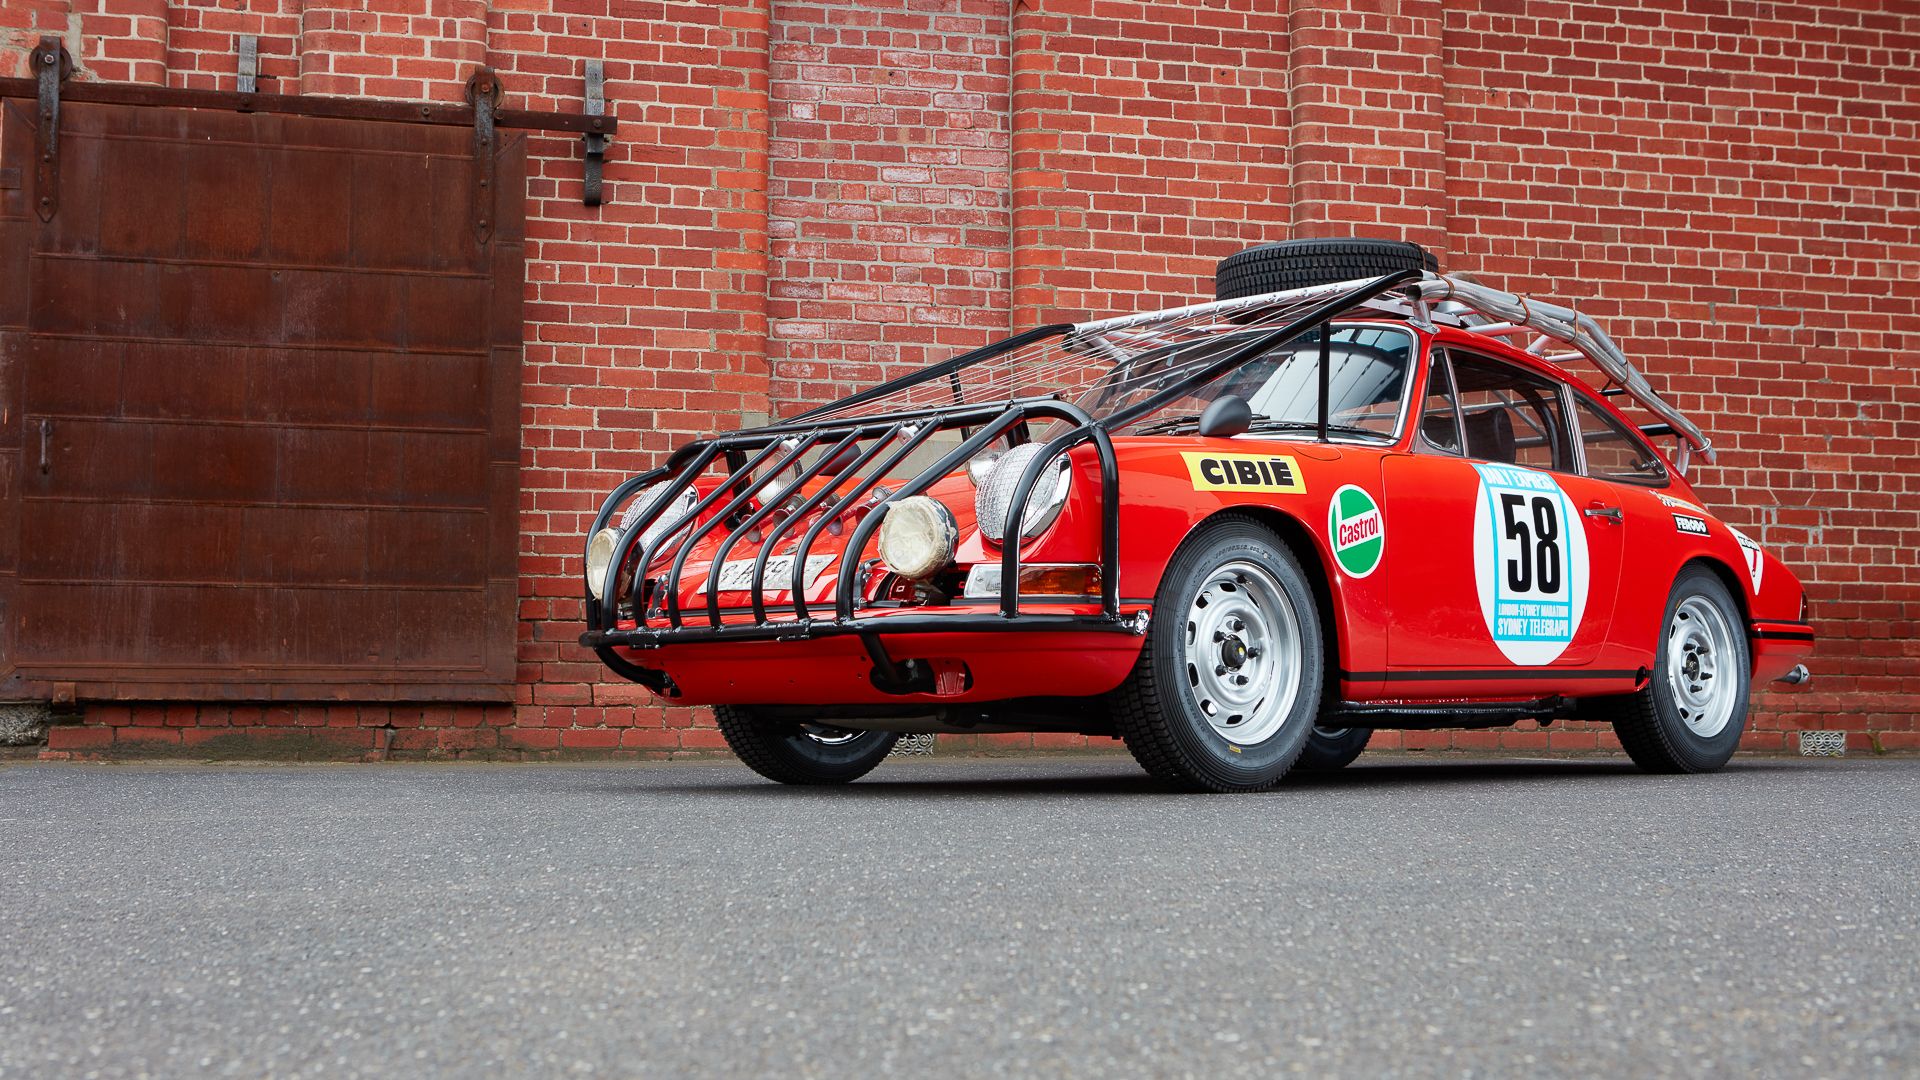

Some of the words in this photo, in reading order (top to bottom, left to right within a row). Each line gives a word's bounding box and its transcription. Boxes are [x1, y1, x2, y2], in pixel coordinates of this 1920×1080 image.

[1481, 467, 1512, 486] DAILY
[1509, 469, 1556, 490] EXPRESS
[1339, 513, 1379, 546] Castrol
[1675, 516, 1707, 533] FERODO
[1500, 493, 1561, 594] 58
[1498, 603, 1541, 617] LONDON-SYDNEY
[1497, 617, 1528, 636] SYDNEY
[1529, 618, 1569, 637] TELEGRAPH
